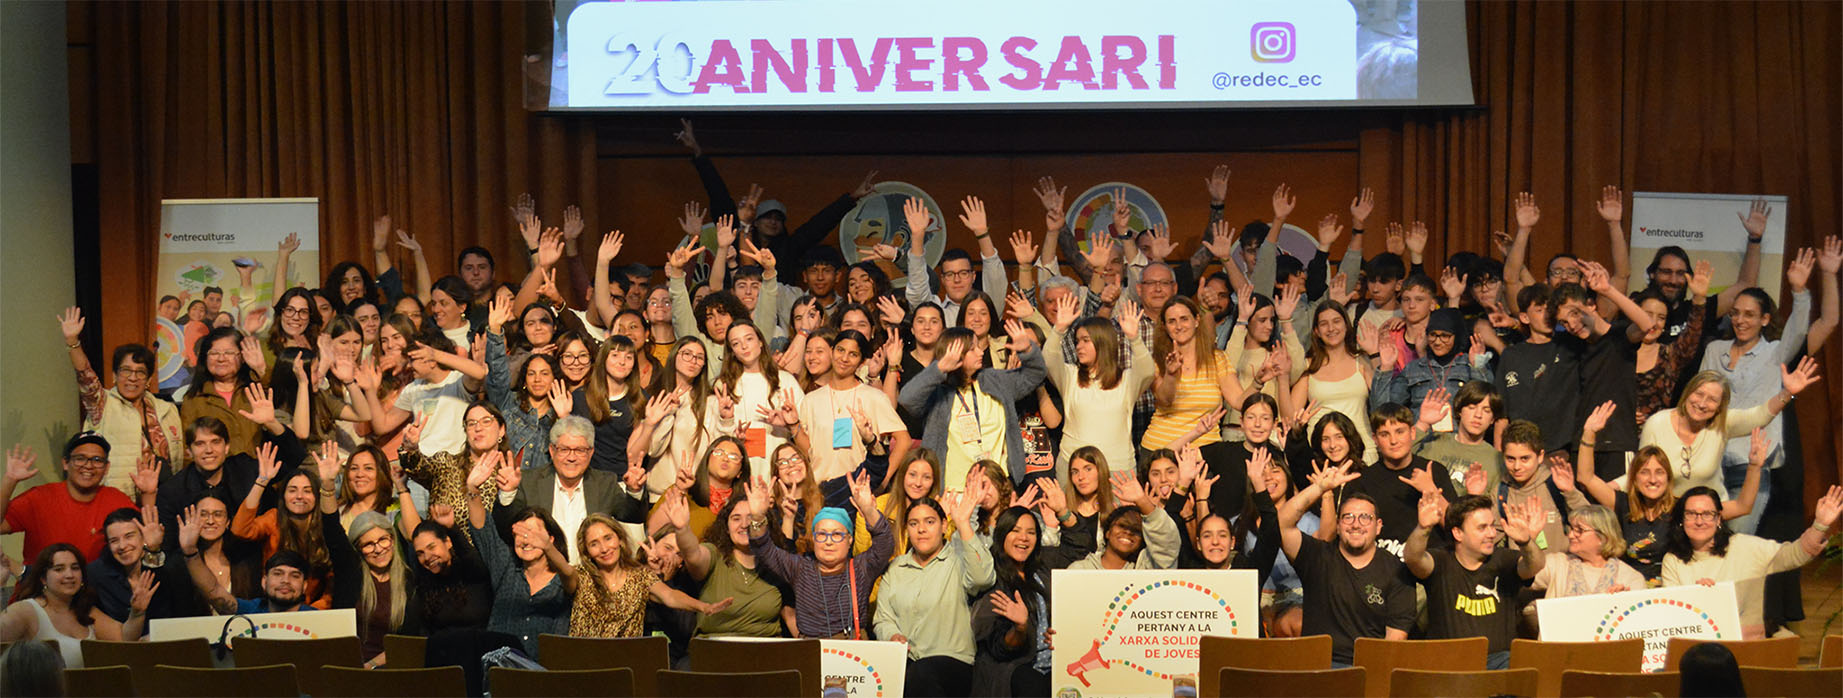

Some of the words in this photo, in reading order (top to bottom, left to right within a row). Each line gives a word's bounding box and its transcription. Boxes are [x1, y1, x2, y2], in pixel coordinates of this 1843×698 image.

[604, 33, 694, 95] 20
[1212, 72, 1323, 90] @redec_ec
[172, 233, 235, 241] entreculturas
[1646, 229, 1703, 238] entreculturas
[1455, 594, 1496, 616] PUMA
[1130, 611, 1173, 619] AQUEST
[1176, 611, 1218, 619] CENTRE
[1138, 624, 1186, 632] PERTANY
[1188, 624, 1195, 632] A
[1198, 624, 1211, 632] LA
[1619, 629, 1659, 639] AQUEST
[1662, 625, 1702, 636] CENTRE
[1120, 636, 1159, 645] XARXA
[1145, 649, 1160, 658] DE
[1163, 649, 1200, 658] JOVES
[825, 675, 865, 683] TRE
